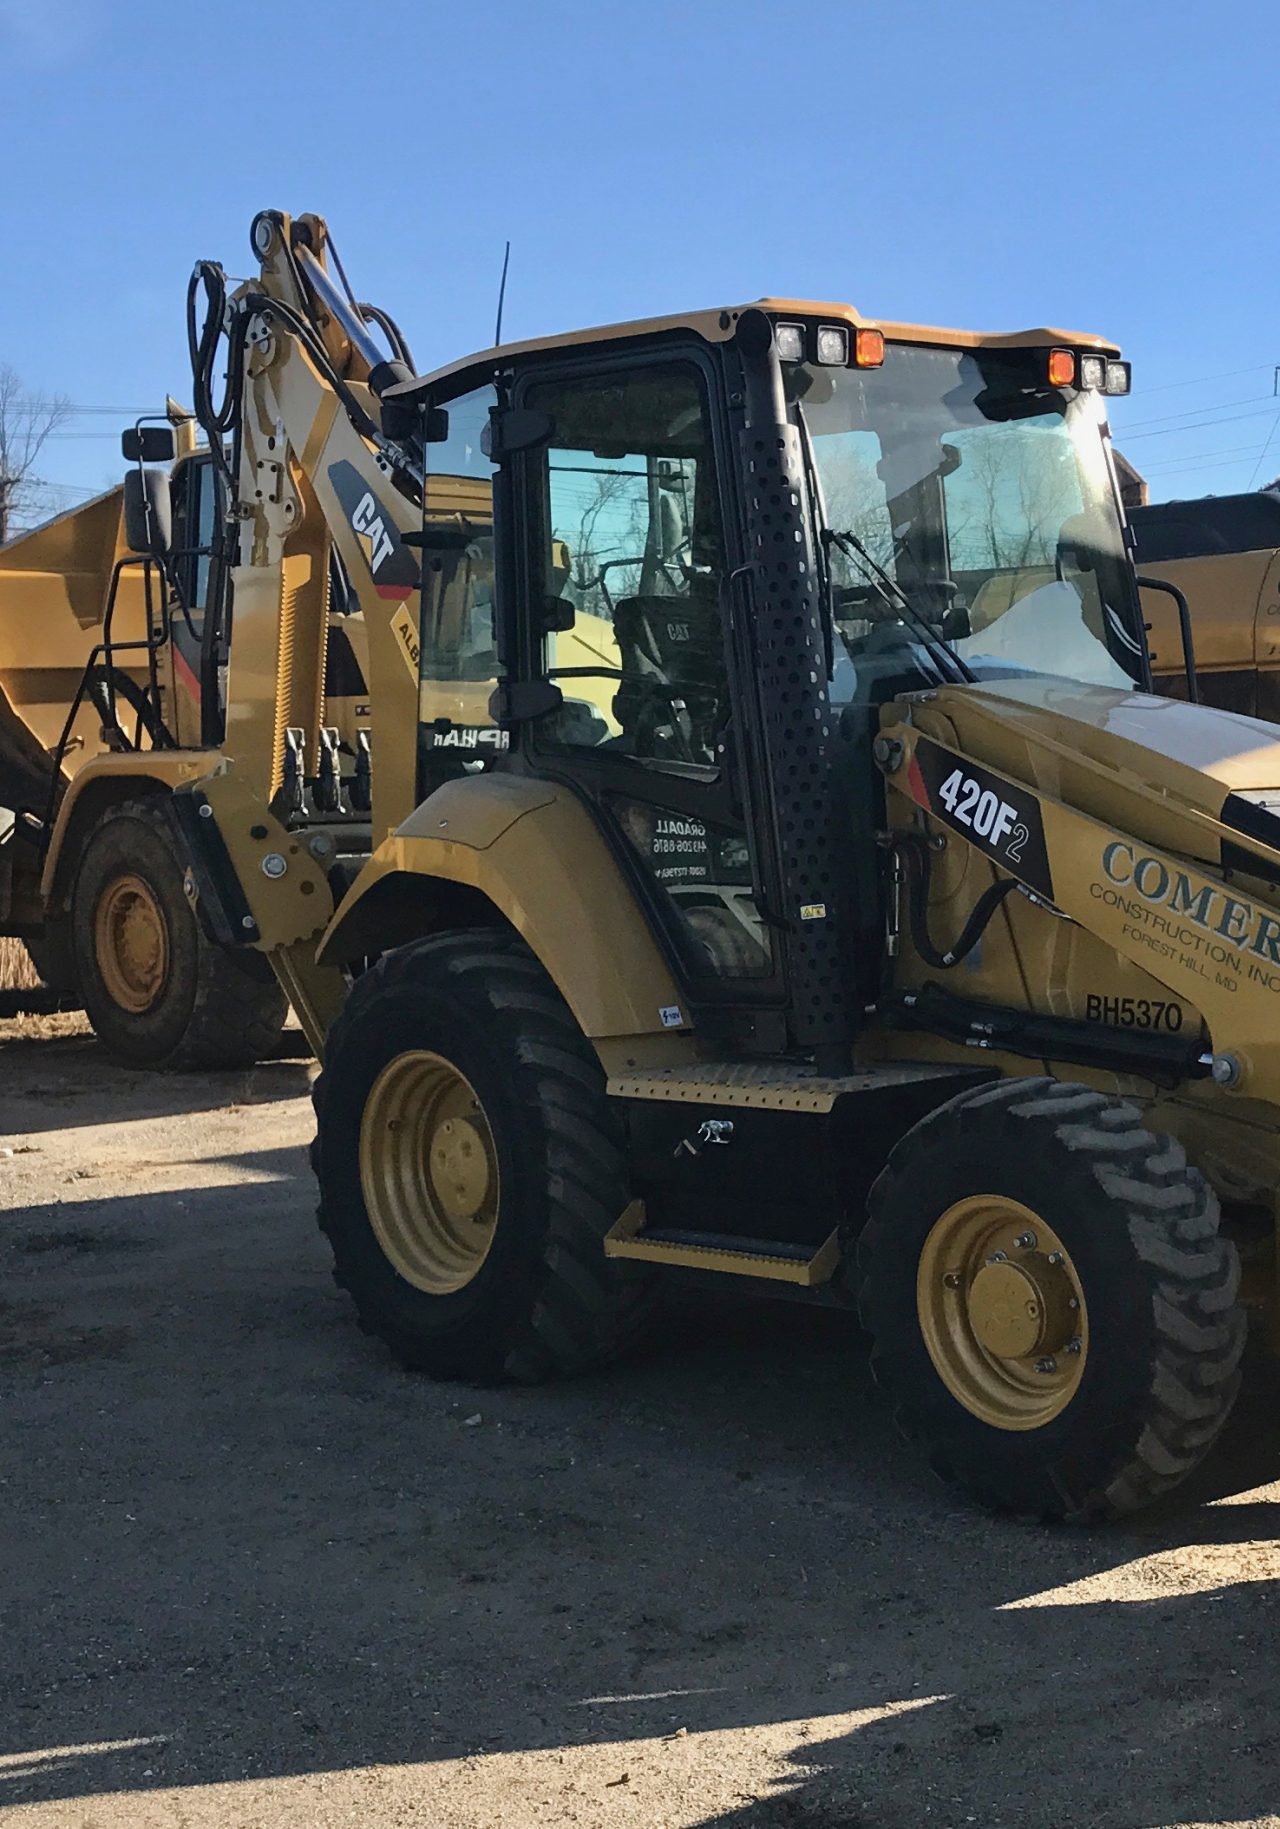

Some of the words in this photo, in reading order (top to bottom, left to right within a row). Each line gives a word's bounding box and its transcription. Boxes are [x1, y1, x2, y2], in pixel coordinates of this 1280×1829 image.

[352, 492, 394, 574] CAT
[398, 623, 420, 667] ALB
[667, 624, 689, 640] CAT
[939, 769, 1029, 863] 420F2
[1089, 883, 1242, 975] CONSTRUCTION,
[1122, 923, 1177, 960] FOREST
[1215, 972, 1238, 993] MD
[1085, 993, 1183, 1032] BH5370
